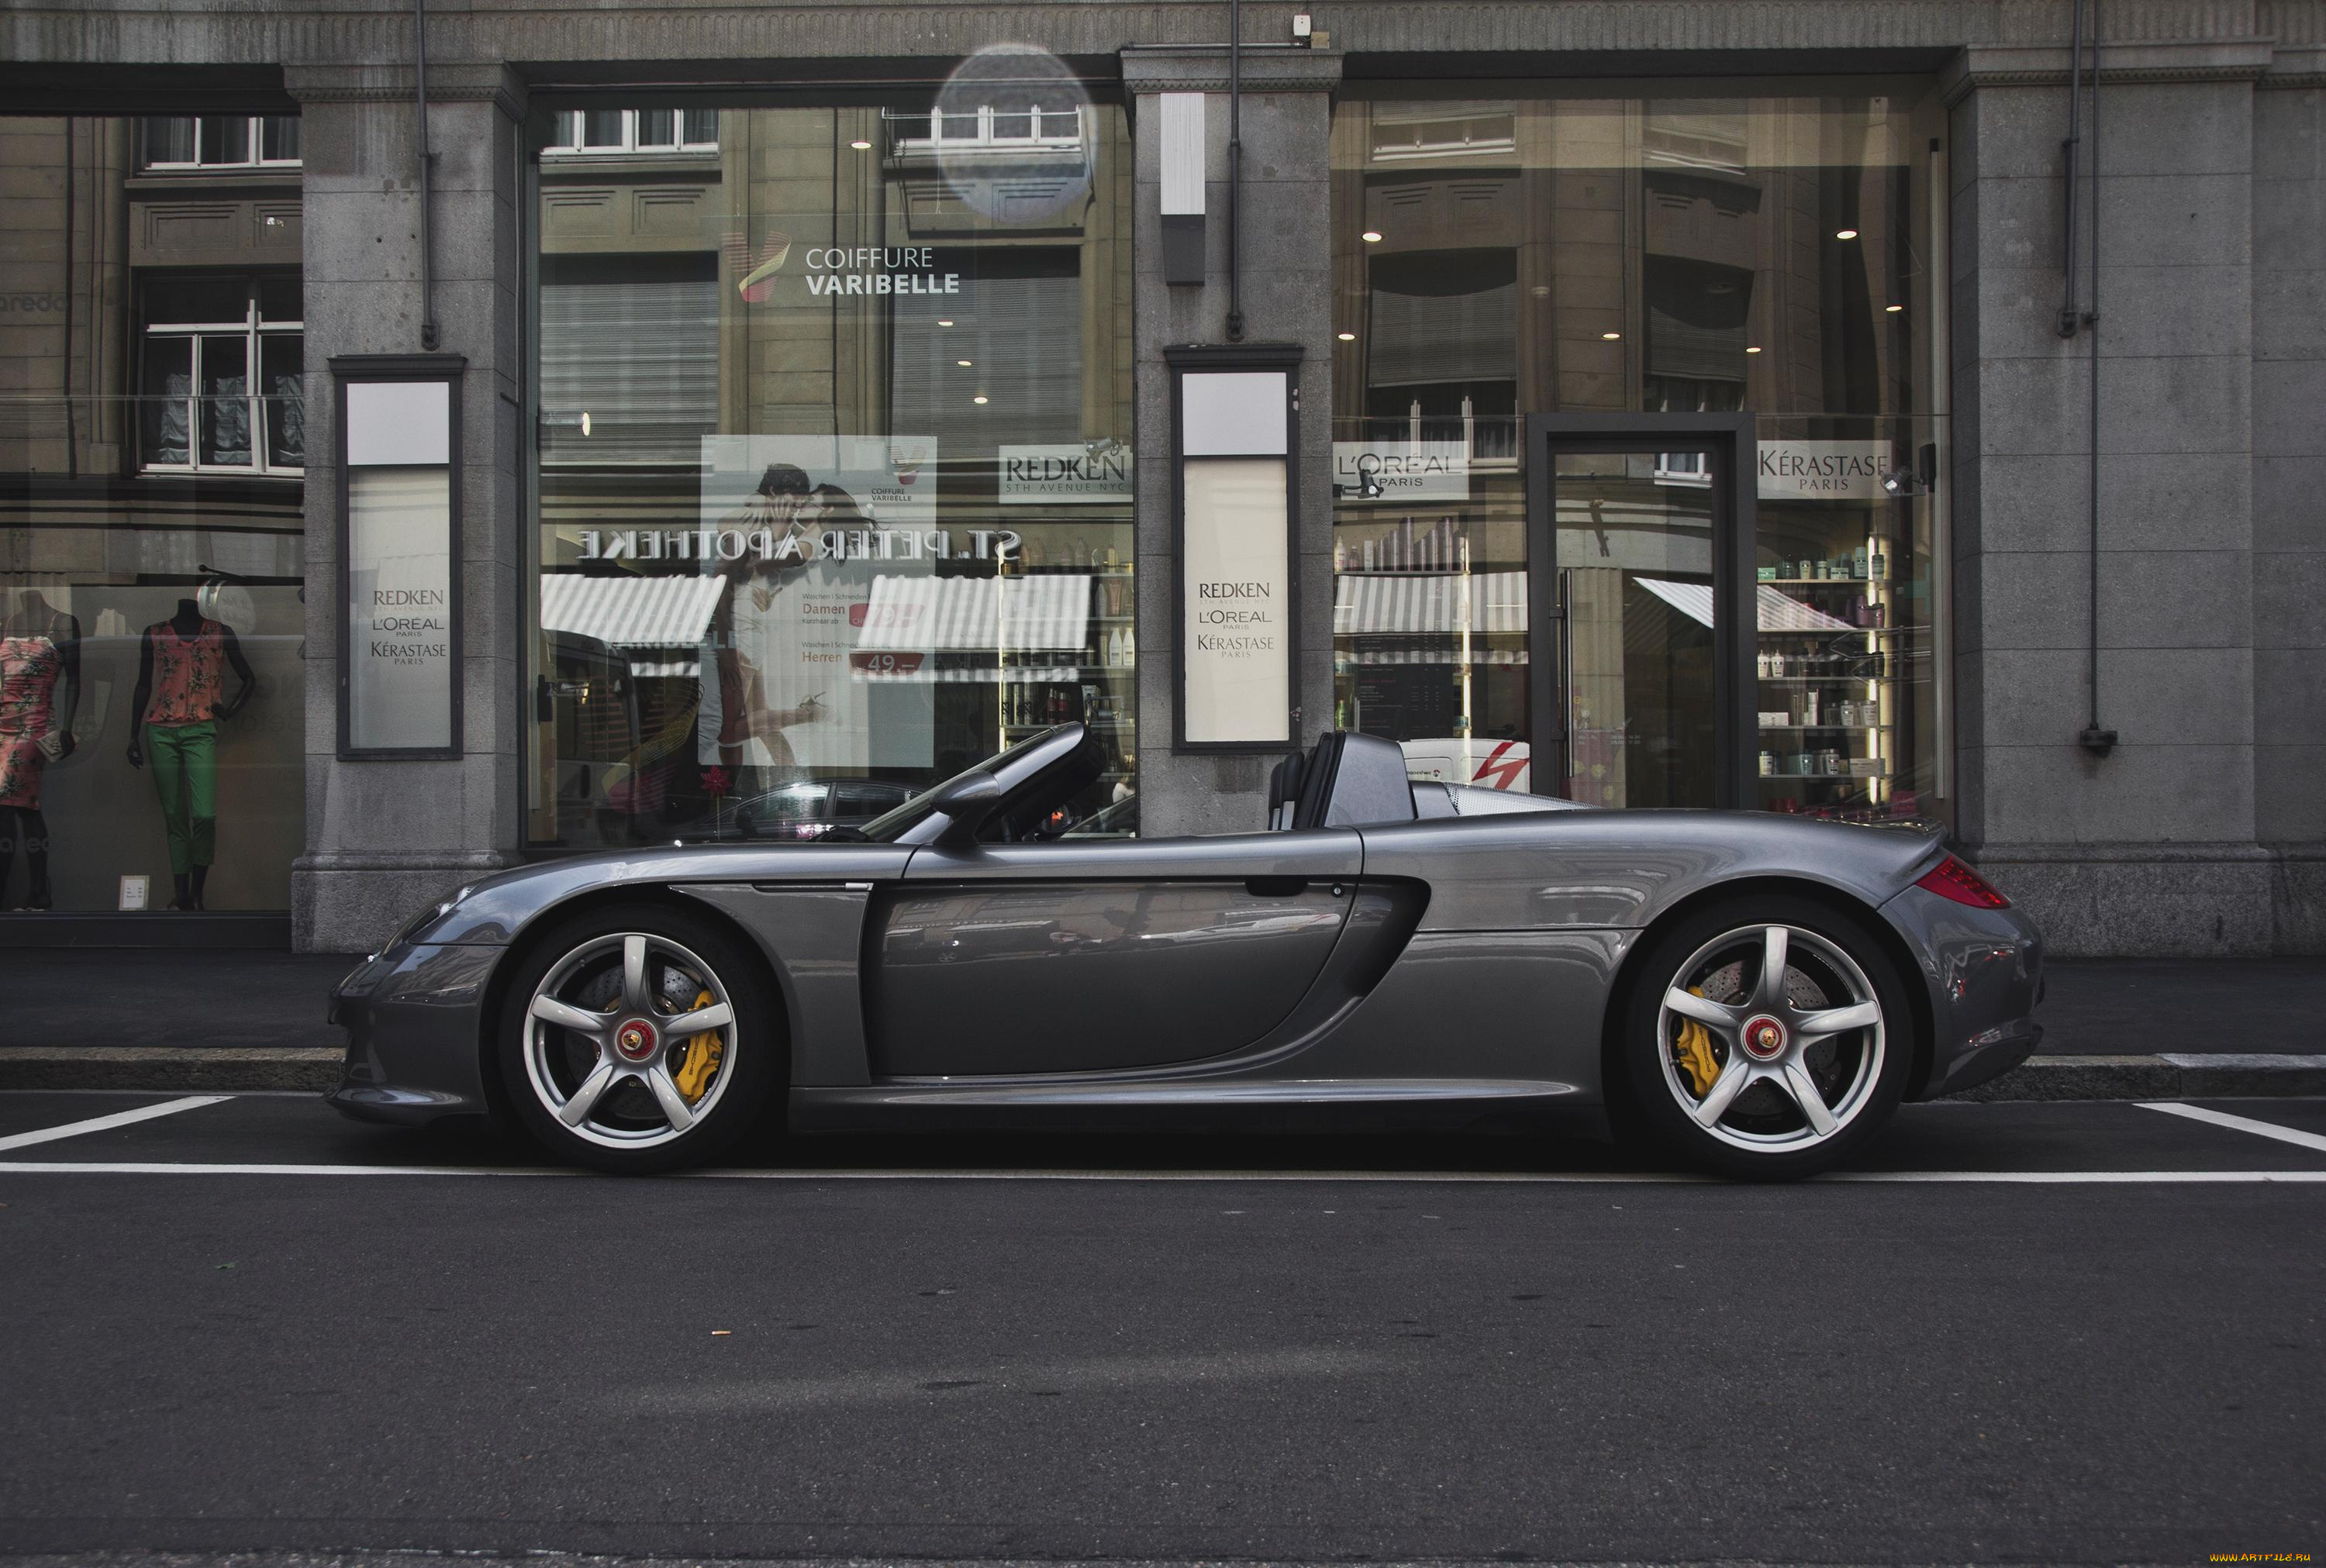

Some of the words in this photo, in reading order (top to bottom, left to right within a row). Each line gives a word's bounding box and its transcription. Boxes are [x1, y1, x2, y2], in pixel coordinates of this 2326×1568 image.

[806, 247, 933, 269] COIFFURE
[806, 274, 959, 295] VARIBELLE
[1006, 456, 1125, 481] REDKEN
[1006, 483, 1031, 493] 5TH
[1038, 483, 1092, 492] AVENUE
[1099, 482, 1125, 491] NYC
[1800, 478, 1849, 490] PARIS
[374, 590, 443, 605] REDKEN
[1199, 583, 1270, 598] REDKEN
[802, 603, 845, 615] Damen
[371, 641, 447, 657] KÉRASTASE
[1198, 634, 1275, 650] KÉRASTASE
[802, 653, 843, 663] Herren
